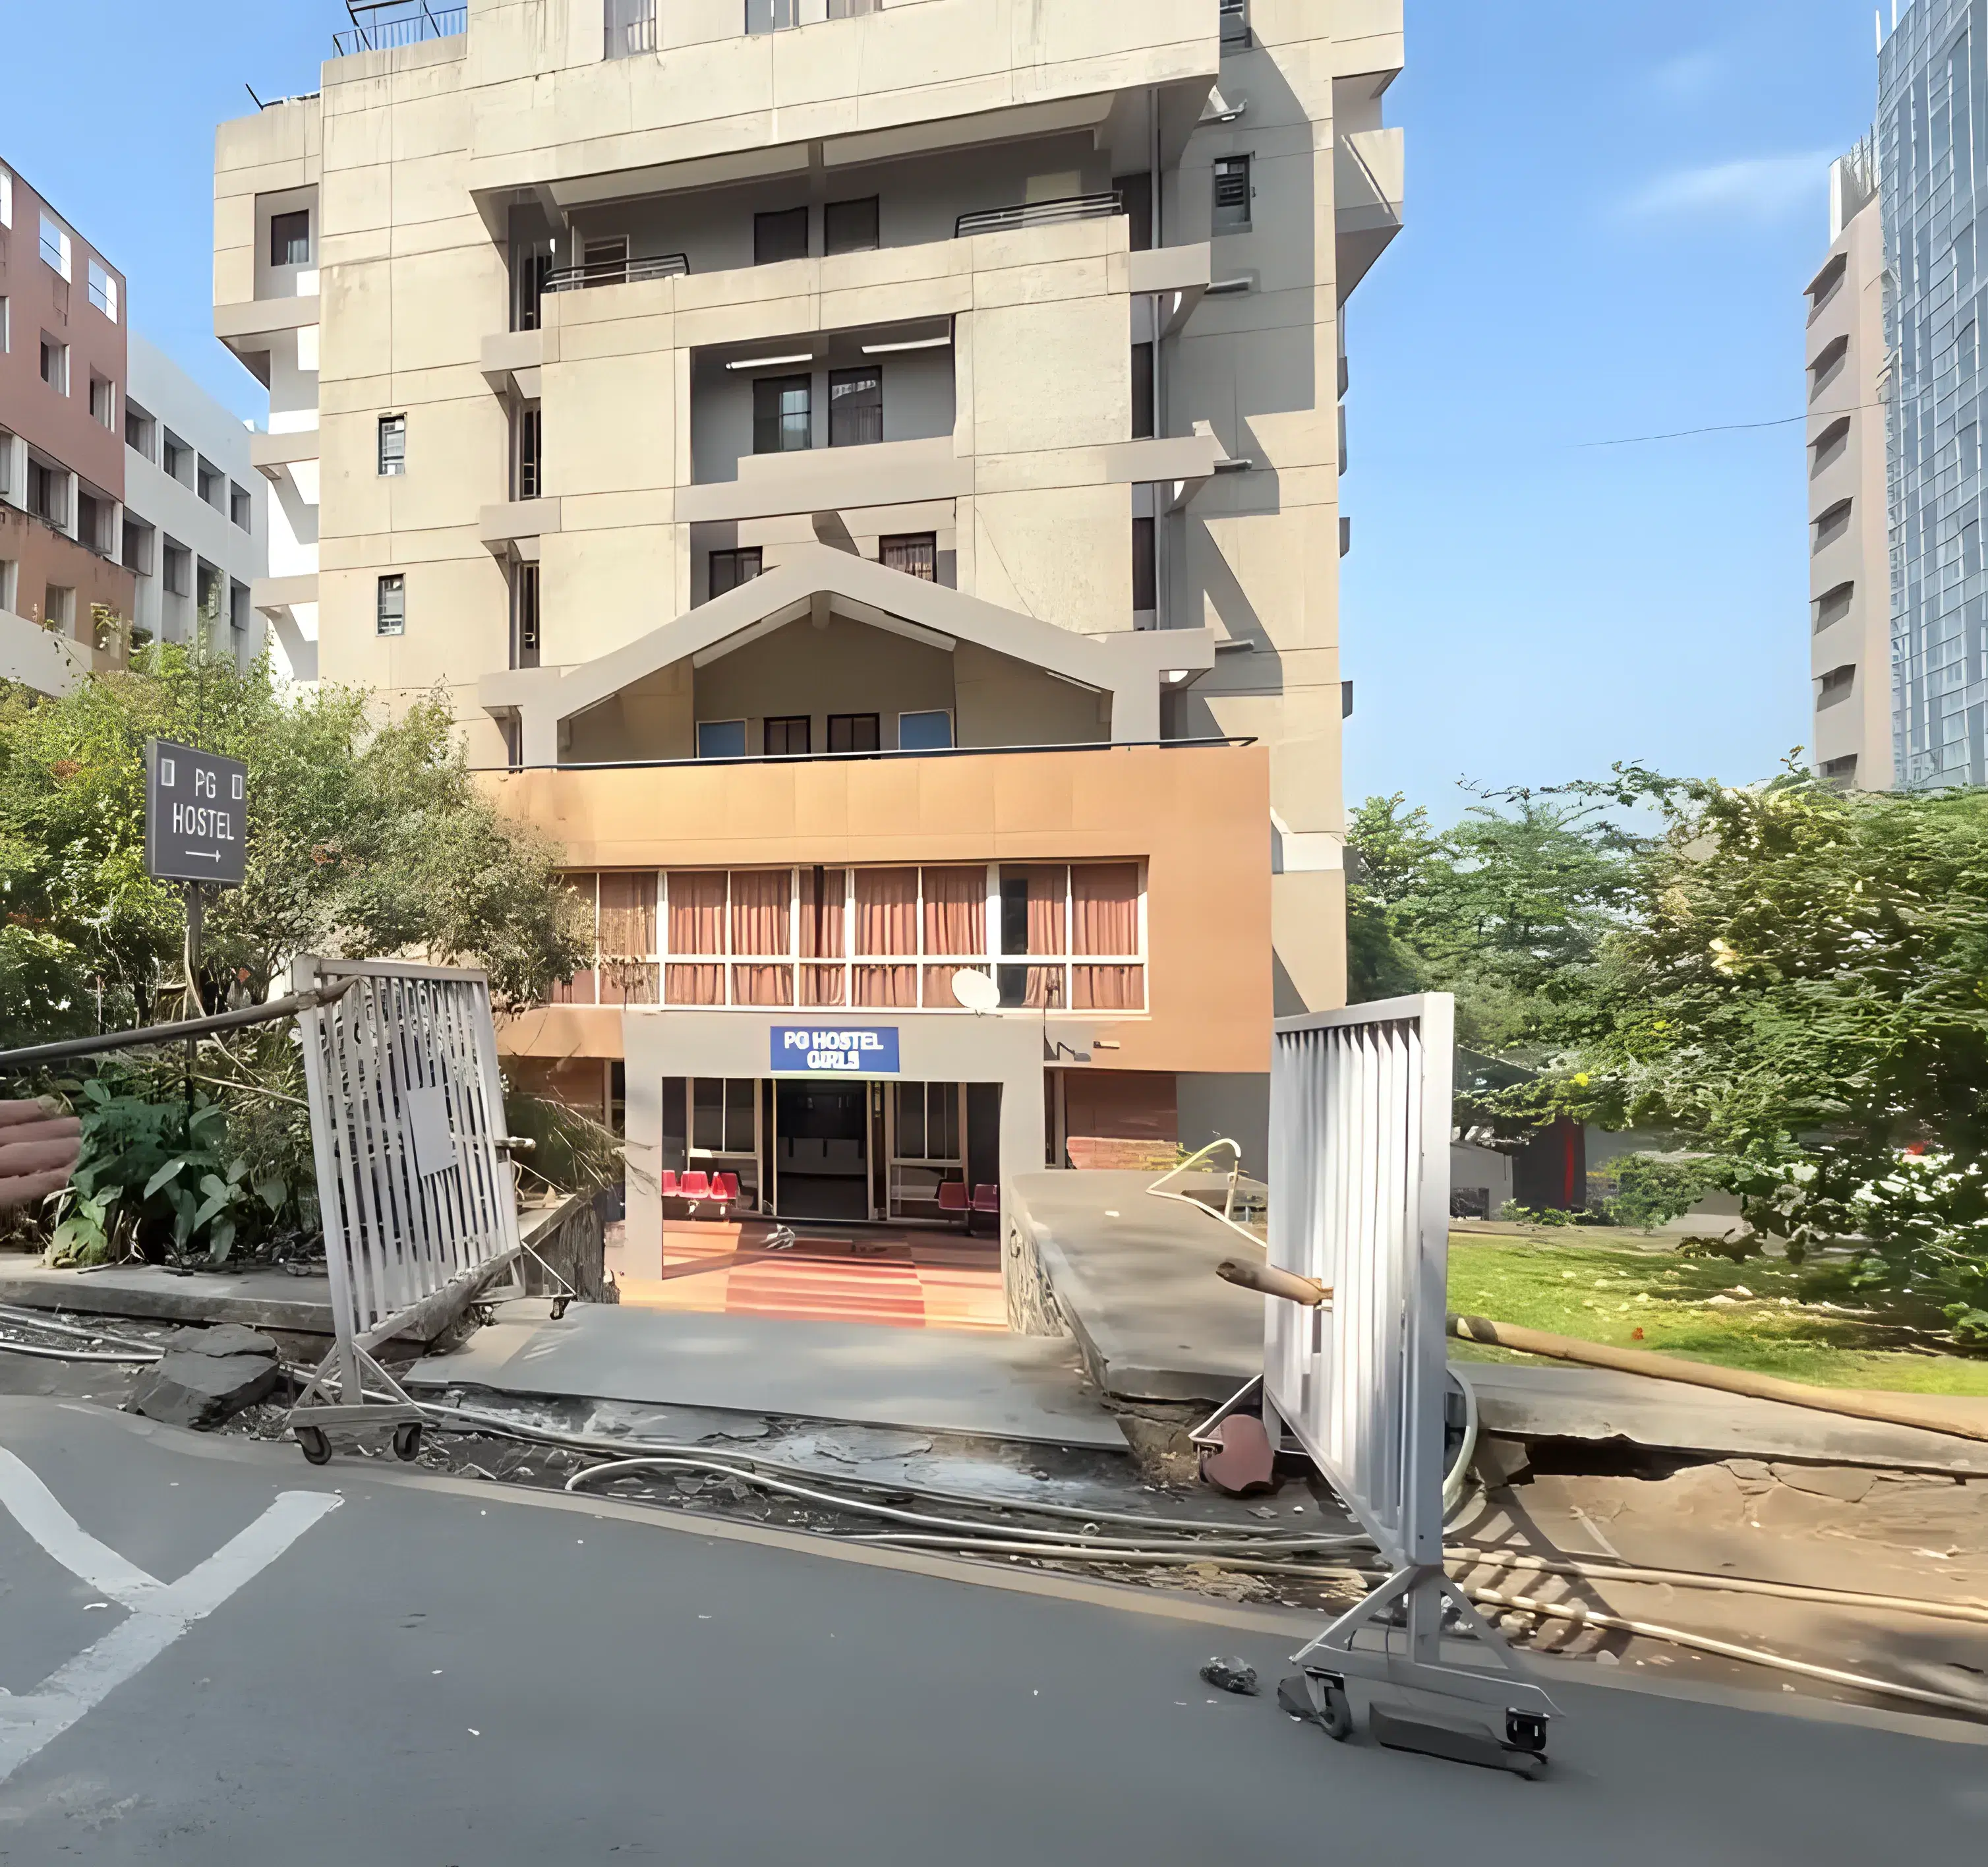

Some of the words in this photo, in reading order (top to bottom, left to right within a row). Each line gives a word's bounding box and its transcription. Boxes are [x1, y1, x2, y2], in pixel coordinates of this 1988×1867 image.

[195, 767, 217, 799] PG
[173, 802, 235, 841] HOSTEL
[811, 1031, 884, 1050] HOSTEL
